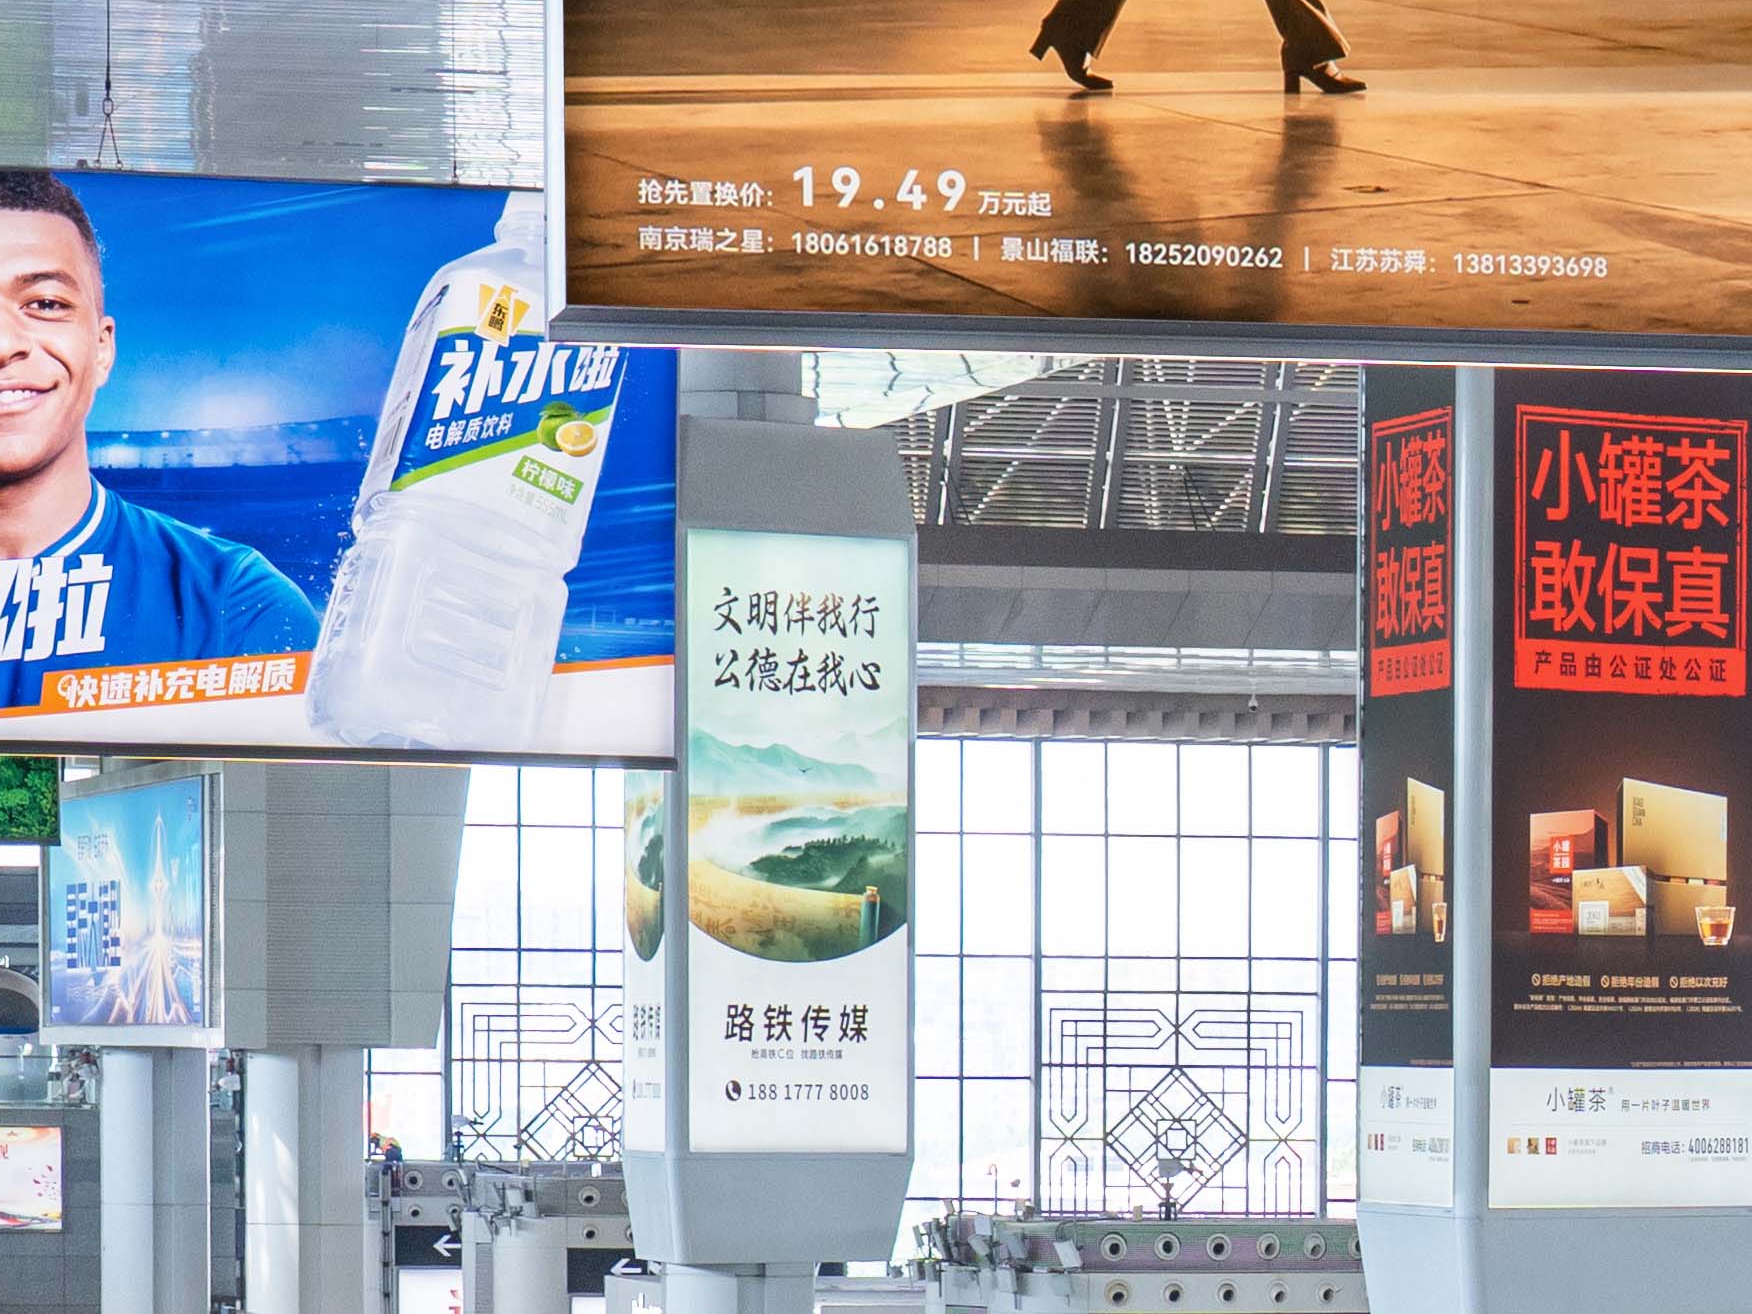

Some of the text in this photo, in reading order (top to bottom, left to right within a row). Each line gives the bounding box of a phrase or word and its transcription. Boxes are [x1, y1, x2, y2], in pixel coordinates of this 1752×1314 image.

[792, 165, 968, 214] 19.49
[977, 191, 1052, 217] 万元起
[791, 230, 953, 258] 18061618788
[1125, 242, 1283, 269] 18252090262
[1452, 251, 1608, 279] 13813393698
[431, 339, 621, 421] 补水啦
[425, 411, 512, 450] 电解质饮料
[521, 459, 577, 499] 柠檬味
[1377, 429, 1446, 530] 小罐茶
[1531, 429, 1730, 530] 小罐茶
[1376, 541, 1445, 638] 敢保真
[1530, 539, 1729, 638] 敢保真
[713, 587, 880, 639] 文明伴我行
[65, 657, 297, 709] 快速补充电解质
[714, 647, 881, 697] 公德在我心
[1535, 650, 1727, 682] 产品由公证处公证
[725, 1003, 870, 1044] 路铁传媒
[748, 1082, 870, 1101] 188 1777 8008
[1547, 1087, 1607, 1112] 小罐茶
[1688, 1137, 1749, 1154] 4006288181
